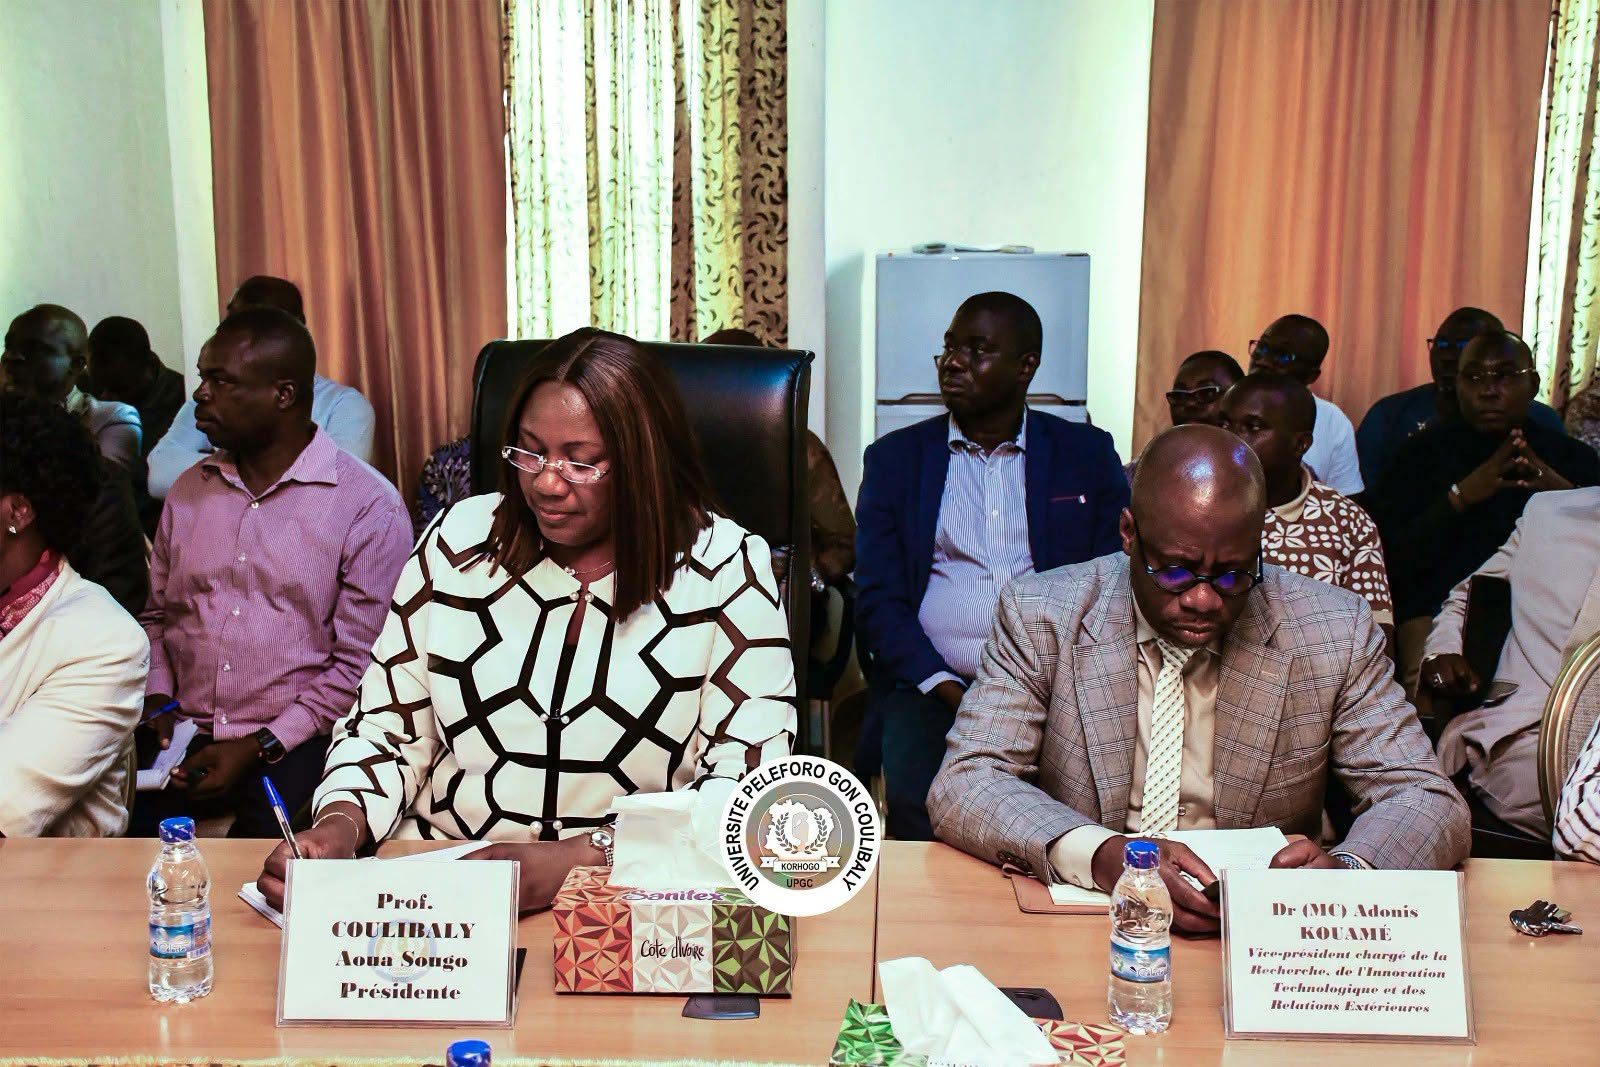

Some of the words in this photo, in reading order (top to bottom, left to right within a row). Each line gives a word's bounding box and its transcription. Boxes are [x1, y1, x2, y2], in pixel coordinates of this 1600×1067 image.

[377, 893, 433, 909] Prof.
[1272, 902, 1296, 916] Dr
[1302, 902, 1347, 919] (MC)
[1353, 904, 1419, 918] Adonis
[331, 921, 476, 938] COULIBALY
[1300, 923, 1392, 941] KOUAMÉ
[335, 950, 393, 967] Aoua
[1249, 947, 1351, 960] Vice-président
[1355, 949, 1406, 962] chargé
[1411, 950, 1428, 960] de
[1433, 951, 1447, 960] la
[1335, 966, 1352, 976] de
[1358, 966, 1446, 978] l'Innovation
[340, 982, 461, 999] Présidente
[1273, 982, 1379, 996] Technologique
[1383, 986, 1396, 994] et
[1401, 985, 1426, 995] des
[1271, 999, 1340, 1010] Relations
[1345, 1000, 1430, 1012] Extérieures
